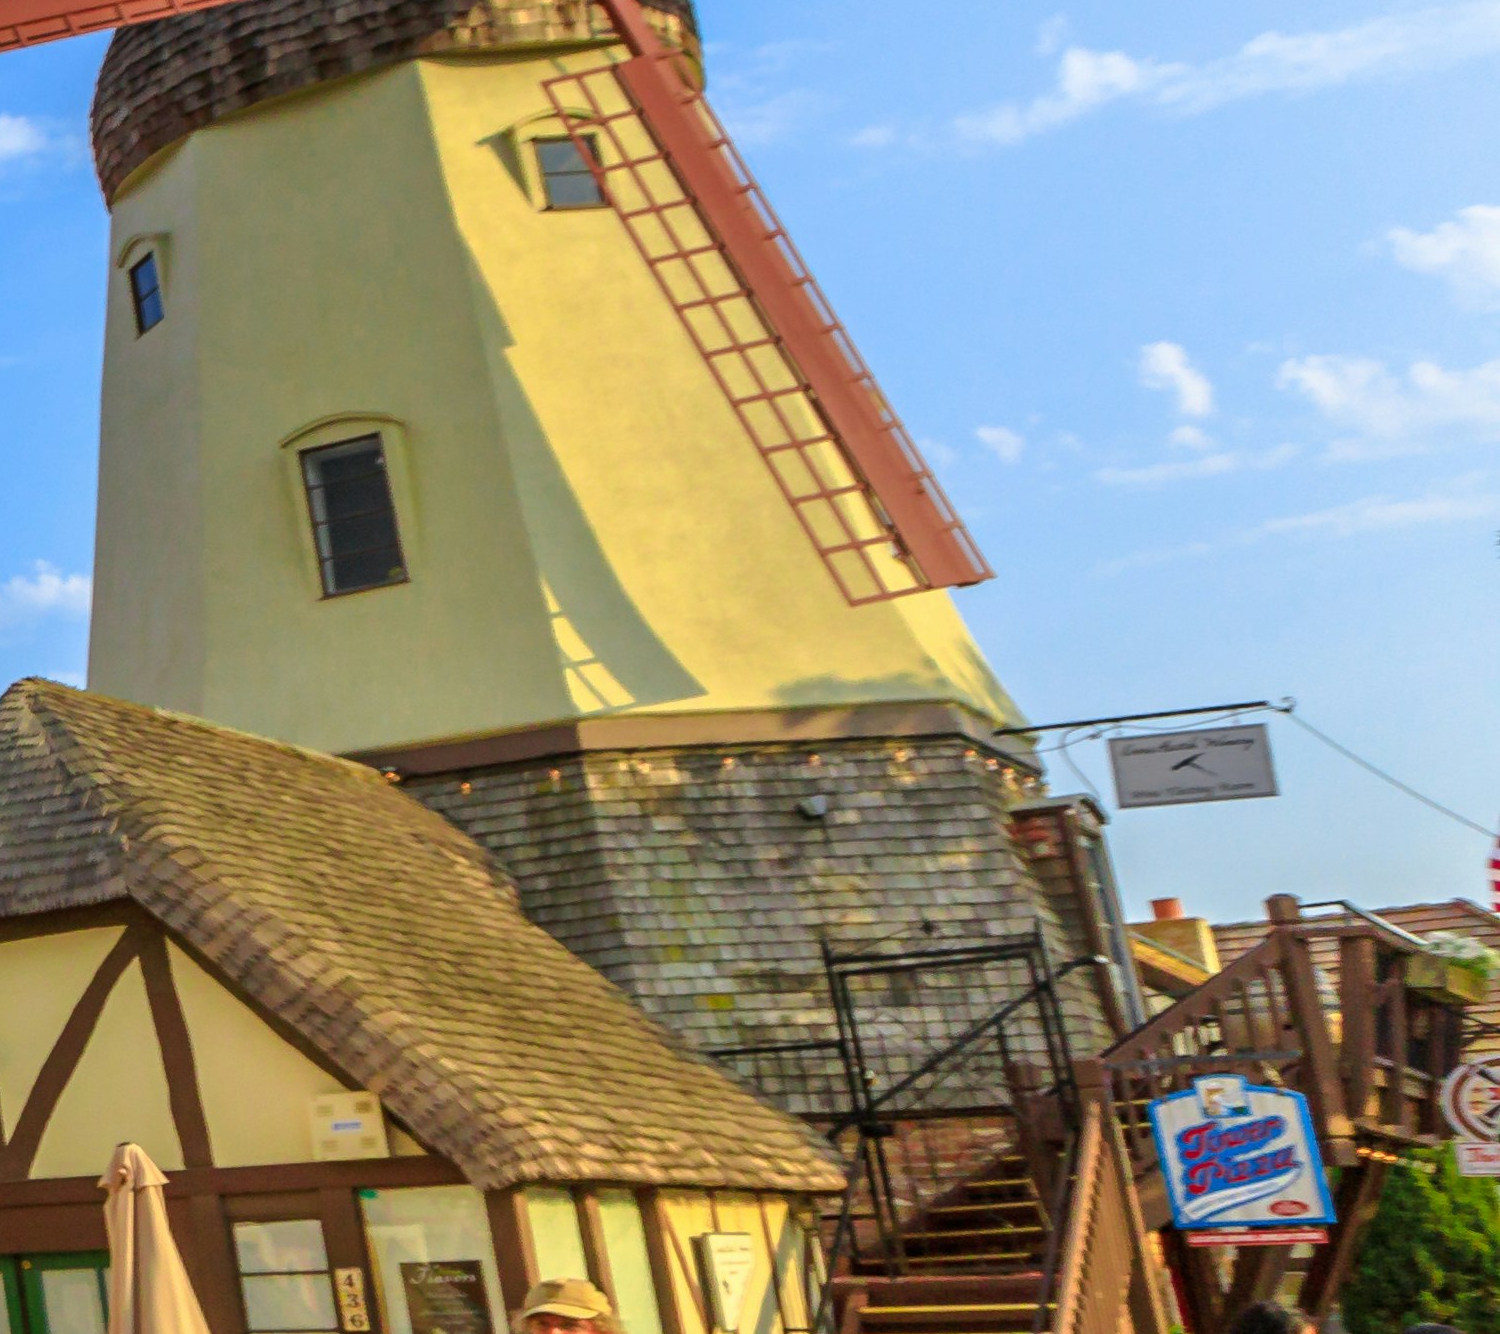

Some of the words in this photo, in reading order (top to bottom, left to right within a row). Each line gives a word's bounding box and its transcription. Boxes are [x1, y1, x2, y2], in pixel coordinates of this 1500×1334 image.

[1181, 1119, 1281, 1159] Tower
[1188, 1145, 1302, 1195] Pizza
[342, 1274, 367, 1328] 436
